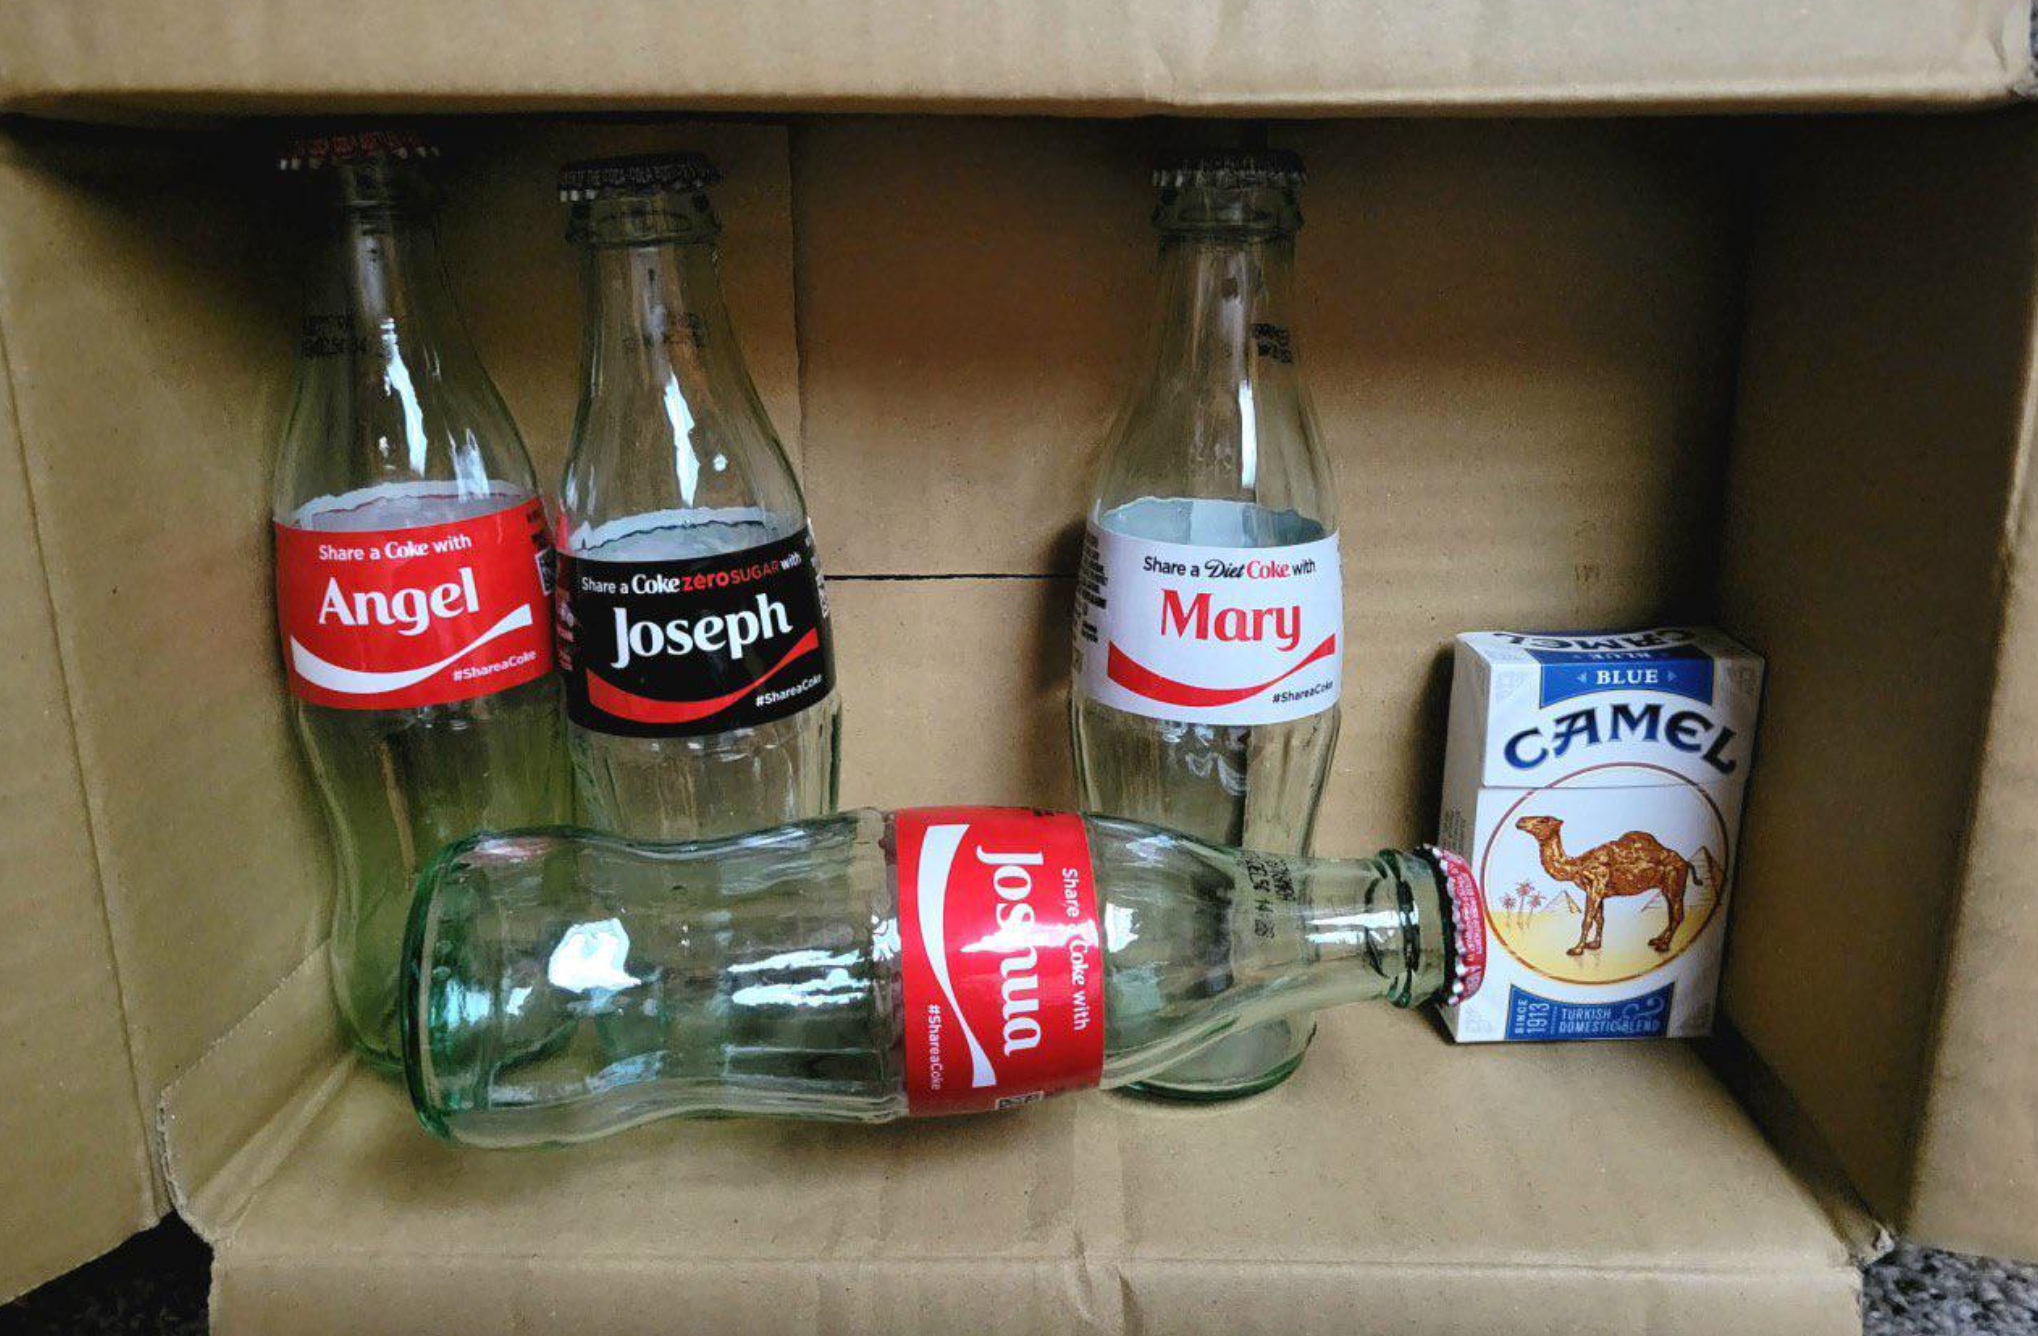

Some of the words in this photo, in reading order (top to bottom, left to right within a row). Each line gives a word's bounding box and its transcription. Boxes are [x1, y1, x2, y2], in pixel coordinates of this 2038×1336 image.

[319, 545, 364, 561] Share
[370, 547, 381, 560] a
[384, 541, 429, 560] Coke
[433, 534, 472, 552] with
[581, 577, 616, 595] Share
[620, 582, 629, 594] a
[632, 573, 681, 595] Coke
[731, 560, 779, 585] SUGAR
[780, 552, 802, 571] with
[1143, 556, 1187, 577] Share
[1190, 563, 1200, 577] a
[1204, 559, 1246, 578] Diet
[1246, 560, 1291, 579] Coke
[1292, 558, 1316, 576] with
[318, 567, 480, 636] Angel
[611, 593, 793, 669] Joseph
[1161, 588, 1301, 652] Mary
[1493, 628, 1697, 650] CAMEL
[453, 650, 537, 682] #ShareaCoke
[1596, 669, 1659, 685] BLUE
[756, 674, 823, 707] #ShareaCoke
[1272, 681, 1334, 703] #ShareaCoke
[1504, 703, 1737, 775] CAMEL
[1062, 868, 1080, 918] Share
[976, 844, 1044, 1057] Joshua
[1068, 938, 1090, 986] Coke
[1072, 991, 1089, 1031] with
[1514, 999, 1528, 1034] SINCE
[1526, 1002, 1550, 1034] 1913
[1559, 1020, 1619, 1034] DOMESTIC
[1561, 1007, 1612, 1020] TURKISH
[927, 1004, 941, 1090] #ShareaCoke
